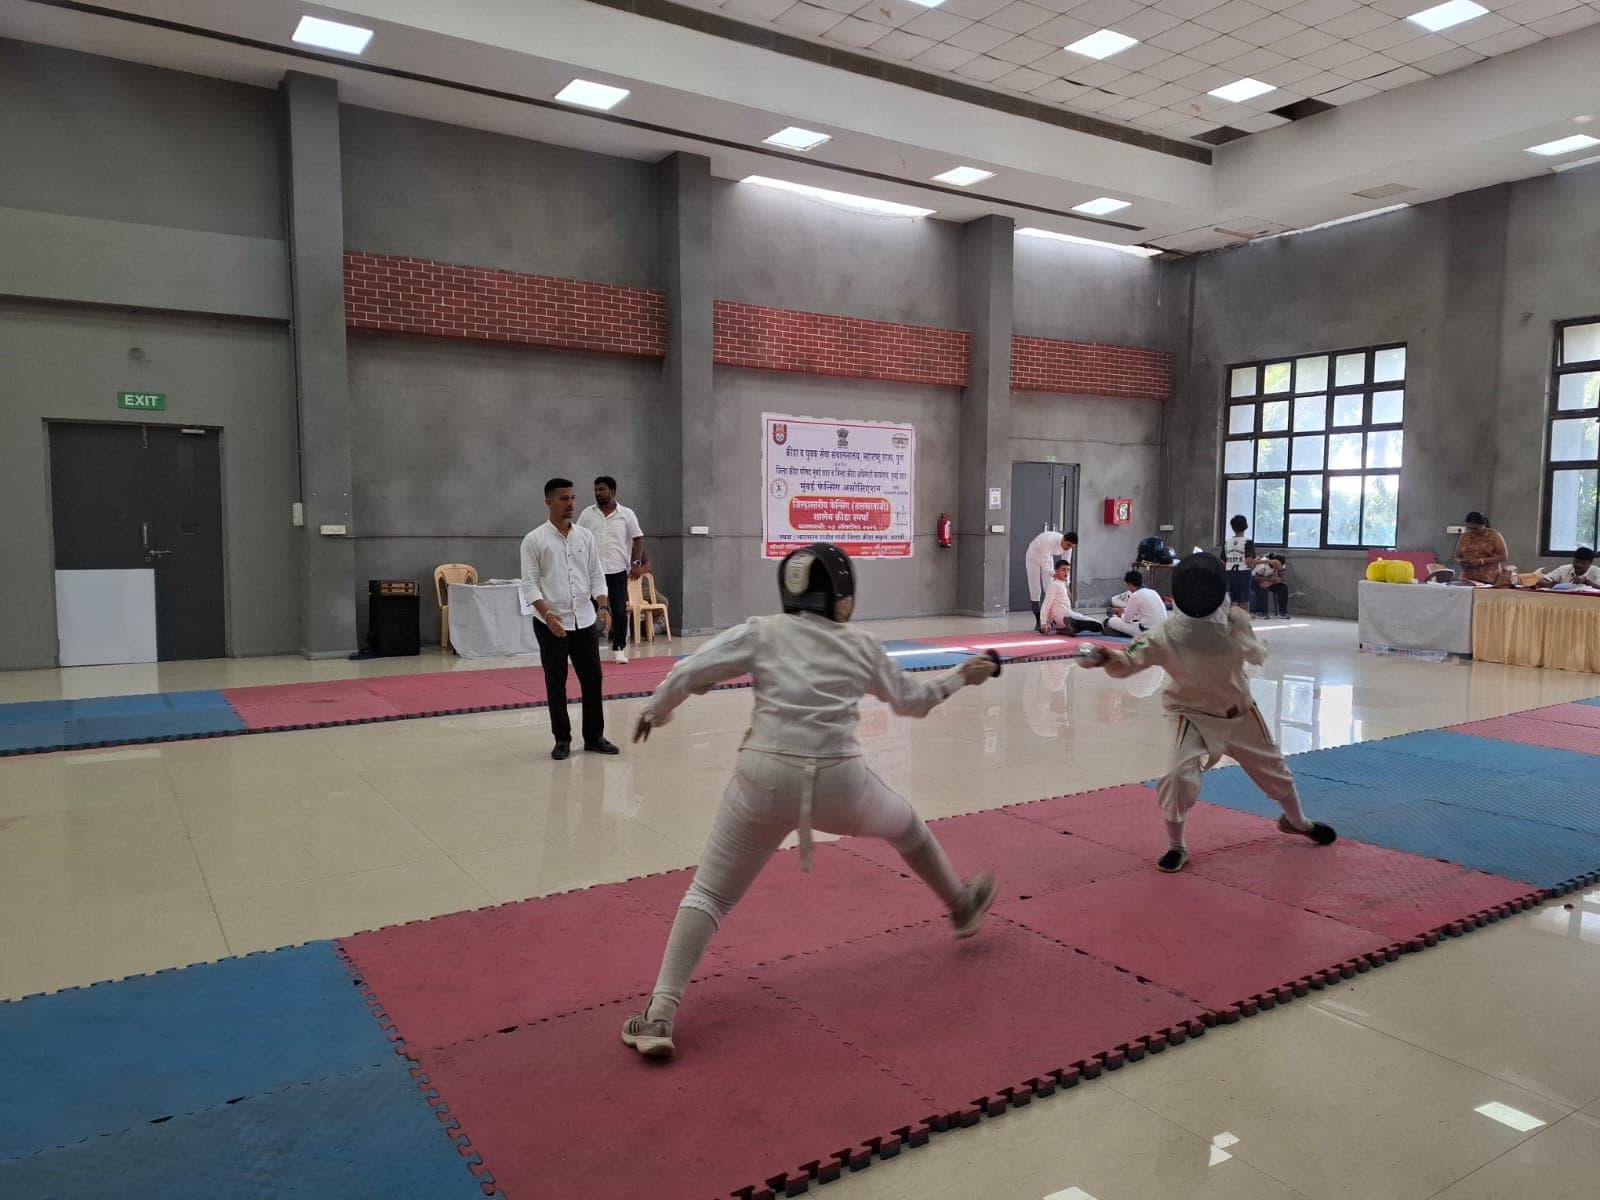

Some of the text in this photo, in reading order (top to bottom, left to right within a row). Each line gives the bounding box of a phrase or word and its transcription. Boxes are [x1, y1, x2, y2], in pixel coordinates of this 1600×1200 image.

[125, 394, 159, 406] EXIT
[800, 480, 814, 492] मुंबई
[817, 480, 840, 490] फेन्सिंग
[842, 482, 880, 493] असोसिएशन
